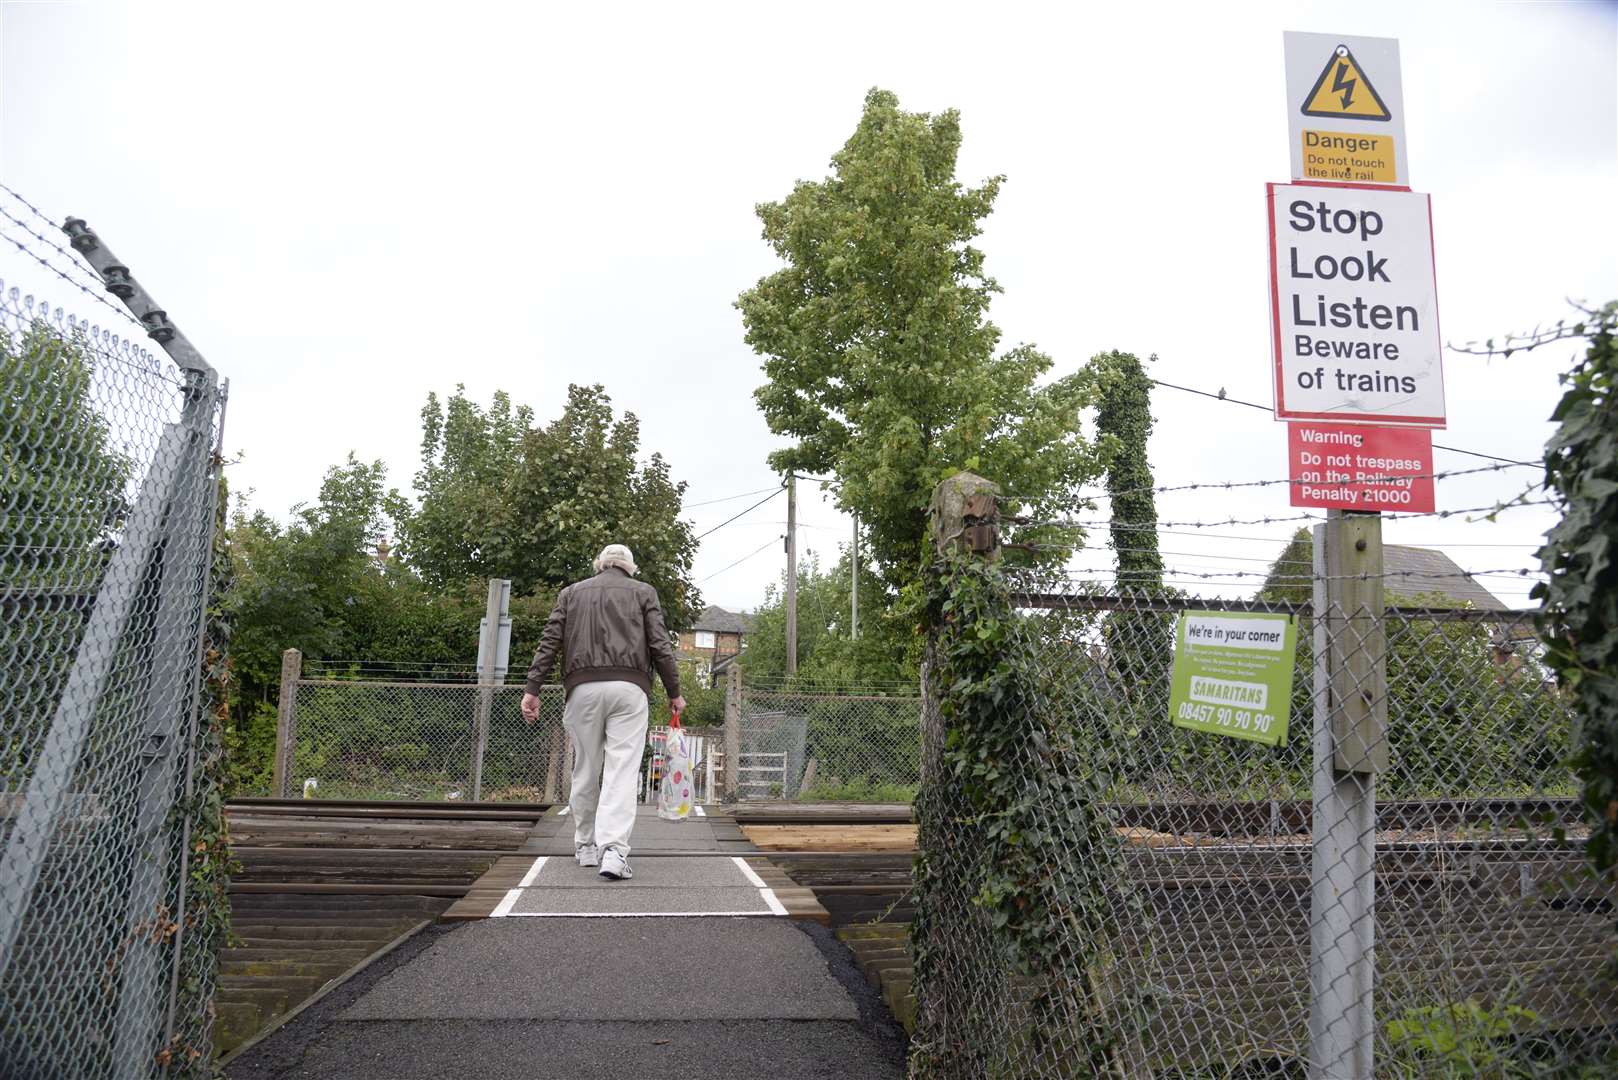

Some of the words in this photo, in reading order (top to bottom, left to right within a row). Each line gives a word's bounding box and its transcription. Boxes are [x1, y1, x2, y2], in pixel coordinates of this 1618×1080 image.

[1305, 132, 1378, 152] Danger
[1308, 154, 1325, 165] Do
[1328, 155, 1347, 166] not
[1351, 157, 1385, 168] touch
[1308, 167, 1328, 177] the
[1332, 168, 1351, 179] live
[1355, 170, 1374, 181] rail
[1289, 200, 1384, 241] Stop
[1290, 247, 1391, 283] Look
[1292, 294, 1419, 331] Listen
[1295, 334, 1400, 361] Beware
[1297, 367, 1324, 390] of
[1335, 368, 1416, 394] trains
[1300, 429, 1363, 447] Warning
[1301, 452, 1321, 465] Do
[1327, 453, 1351, 467] not
[1356, 454, 1422, 471] trespass
[1302, 471, 1320, 483] on
[1326, 470, 1350, 483] the
[1356, 471, 1414, 489] Railway
[1302, 486, 1358, 503] Penalty
[1188, 624, 1213, 638] We're
[1215, 625, 1223, 639] in
[1224, 630, 1246, 643] your
[1248, 631, 1280, 643] corner
[1193, 681, 1263, 704] SAMARITANS
[1178, 702, 1215, 723] 08457
[1216, 708, 1232, 726] 90
[1234, 710, 1251, 729] 90
